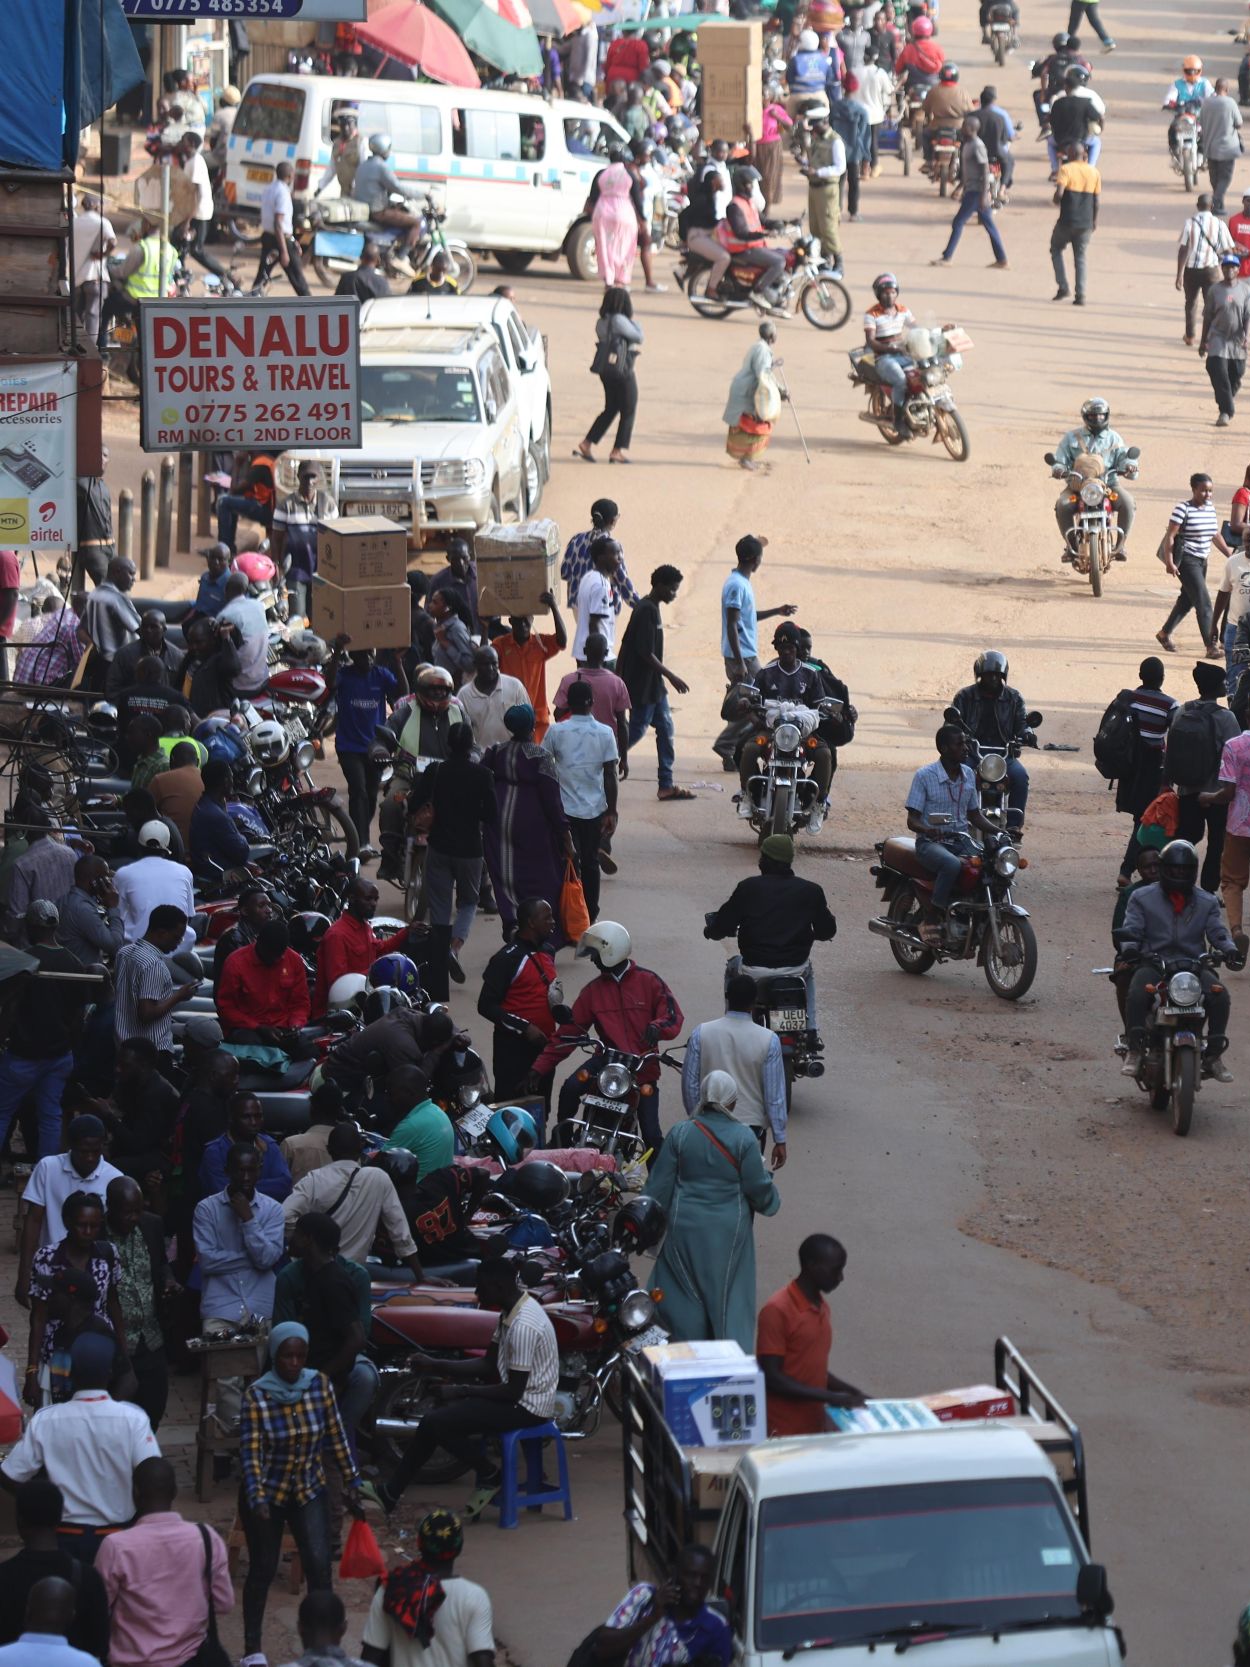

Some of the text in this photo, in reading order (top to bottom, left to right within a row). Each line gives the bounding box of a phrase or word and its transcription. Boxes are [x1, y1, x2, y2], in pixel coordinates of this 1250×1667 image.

[153, 314, 350, 359] DENALU
[155, 363, 350, 393] TOURS & TRAVEL
[185, 402, 351, 424] 0775 262 491
[158, 427, 351, 443] RM NO: C1 2ND FLOOR
[31, 528, 63, 542] airtel
[783, 1010, 804, 1020] UEU
